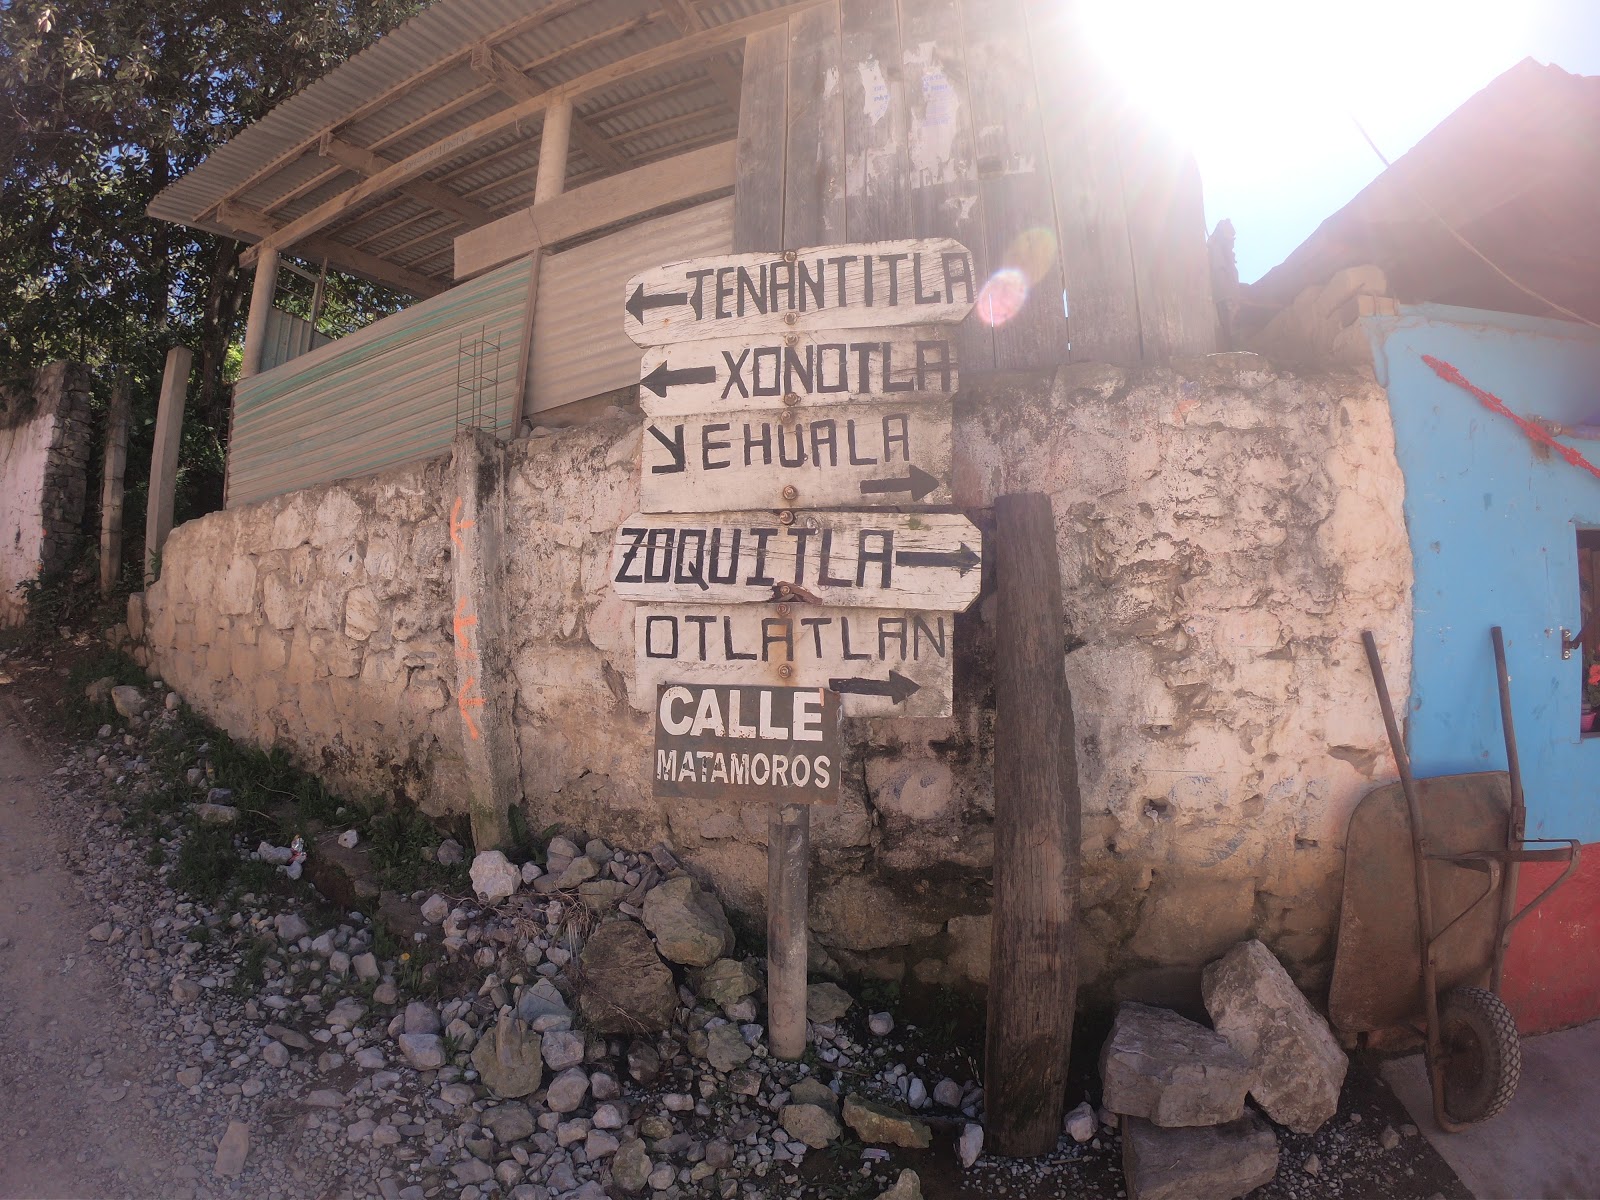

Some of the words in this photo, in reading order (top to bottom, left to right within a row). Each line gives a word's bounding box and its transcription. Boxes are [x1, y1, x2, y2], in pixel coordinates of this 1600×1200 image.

[686, 253, 974, 320] TENANTITLA
[721, 340, 949, 399] XONOTLA
[647, 413, 910, 473] YEHUALA
[615, 527, 894, 591] ZOQUITLA
[646, 615, 946, 661] OTLATLAN
[659, 686, 823, 742] CALLE
[656, 749, 831, 788] MATAMOROS
